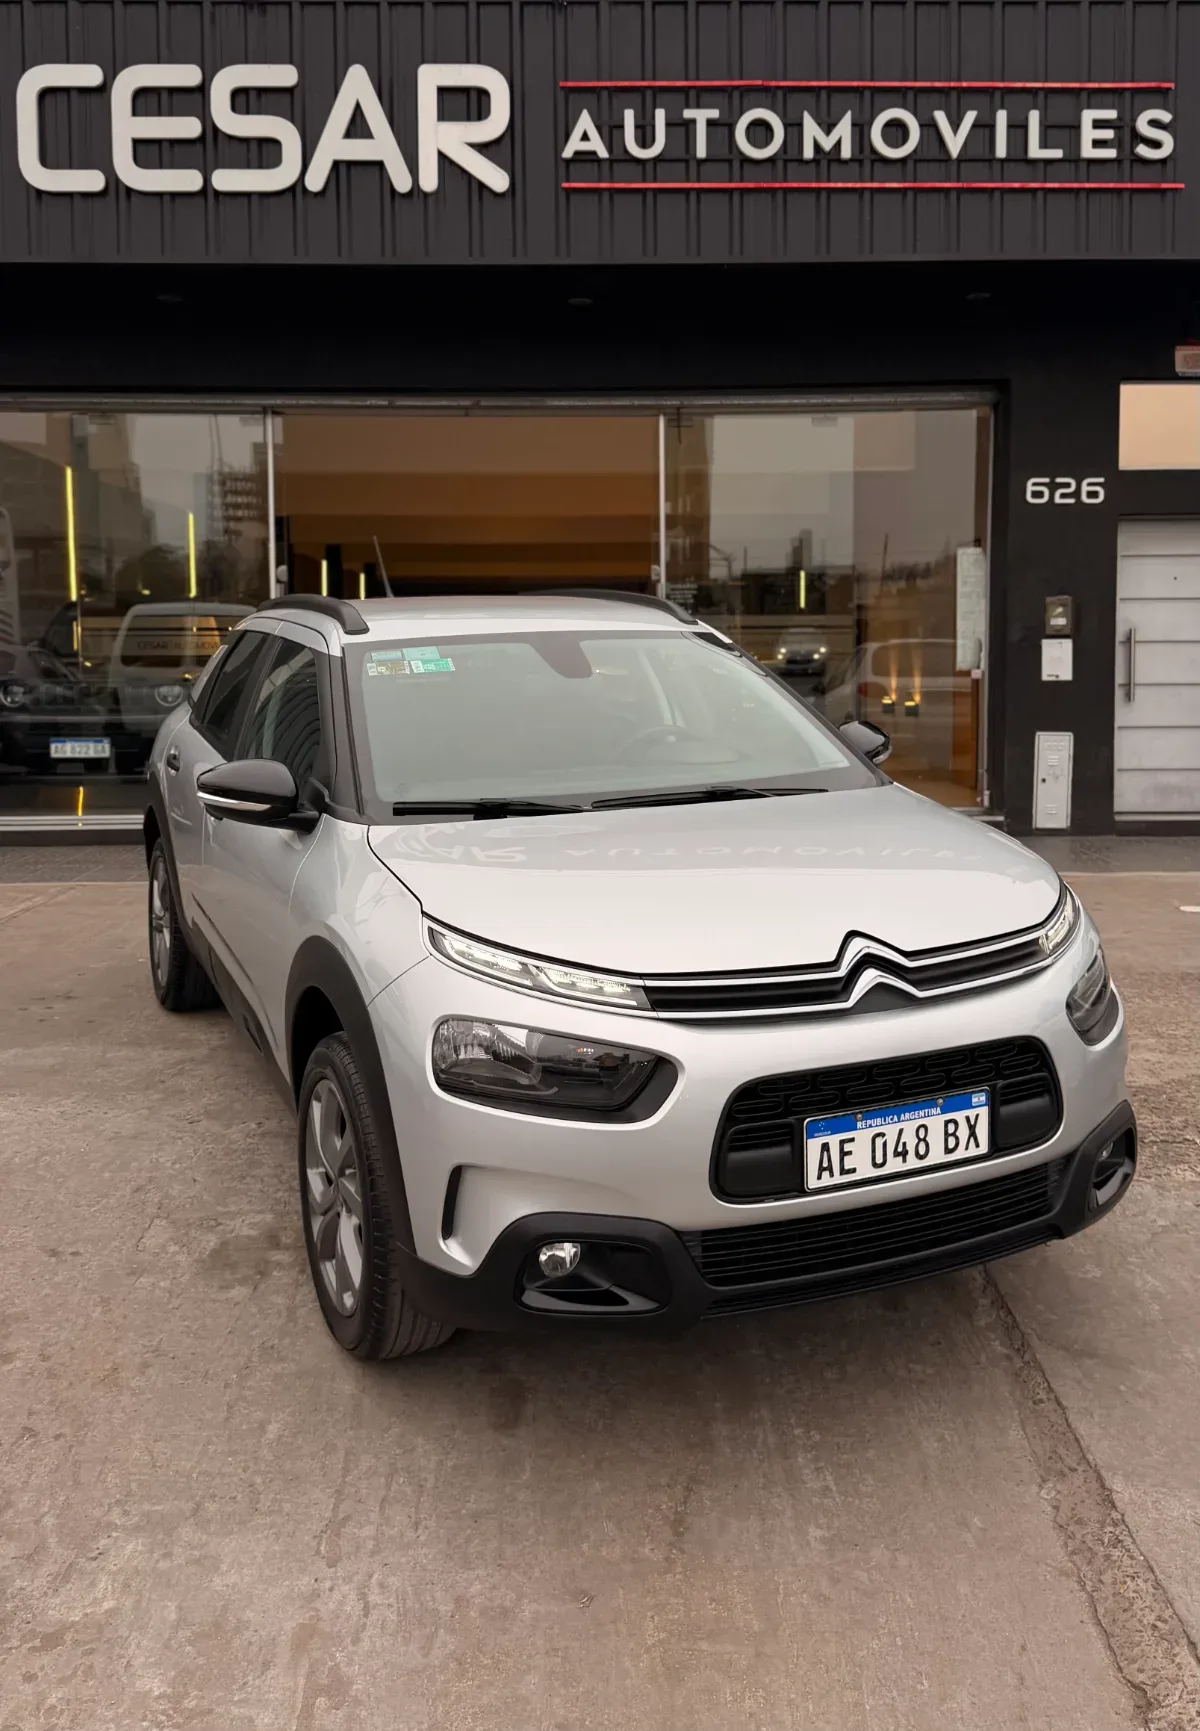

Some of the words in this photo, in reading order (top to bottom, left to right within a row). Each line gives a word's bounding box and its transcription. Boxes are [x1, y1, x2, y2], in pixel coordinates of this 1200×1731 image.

[16, 64, 511, 193] CESAR
[562, 108, 1175, 160] AUTOMOVILES
[1026, 477, 1105, 504] 626
[857, 1115, 898, 1129] REPUBLICA
[900, 1107, 941, 1121] ARGENTINA
[816, 1137, 857, 1181] AE
[871, 1123, 930, 1169] 048
[943, 1113, 980, 1155] BX
